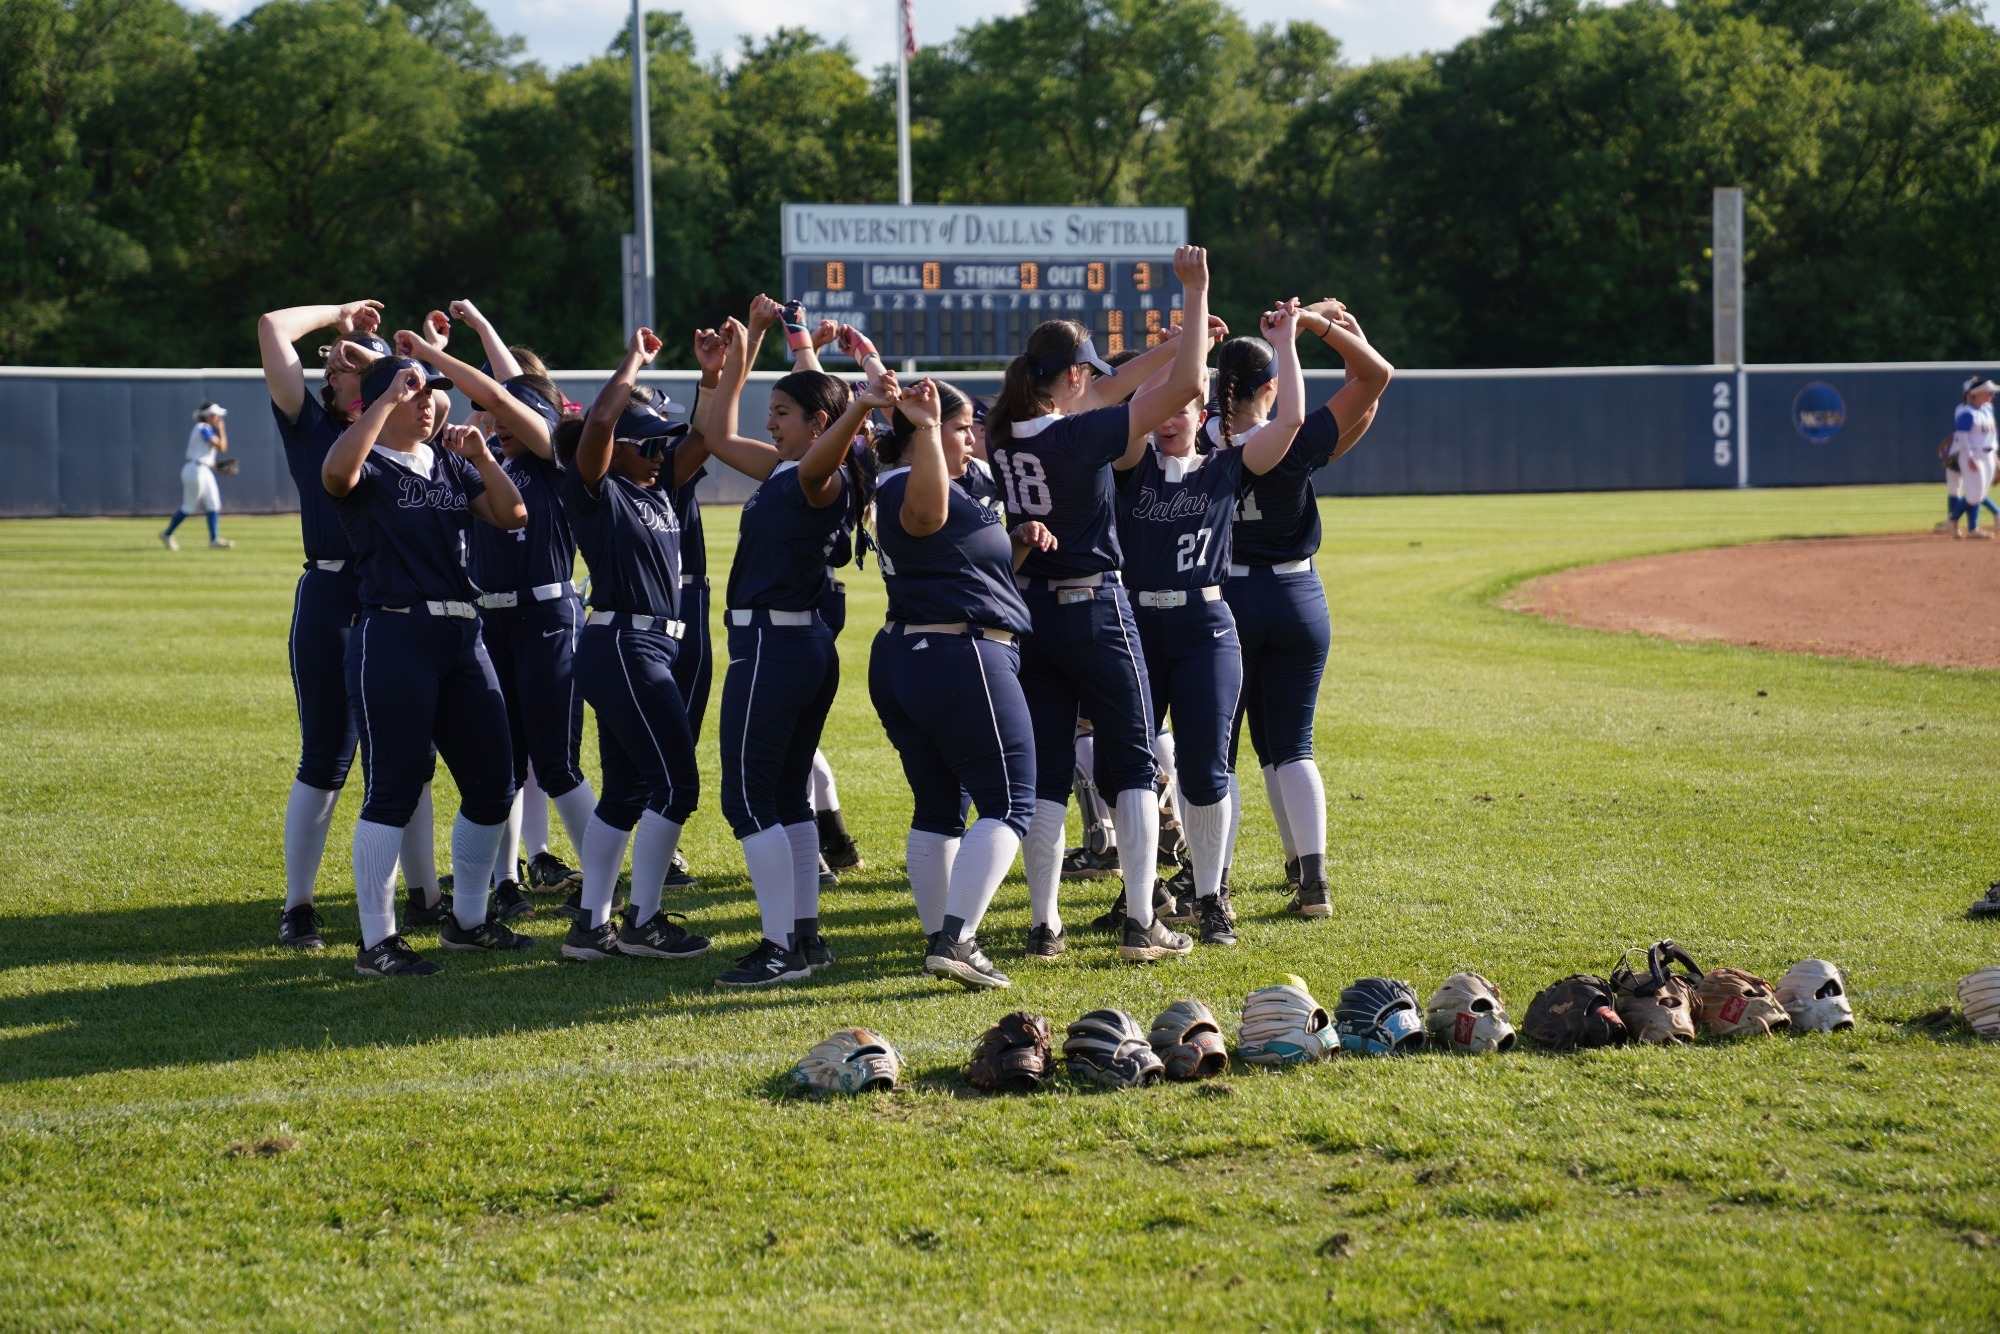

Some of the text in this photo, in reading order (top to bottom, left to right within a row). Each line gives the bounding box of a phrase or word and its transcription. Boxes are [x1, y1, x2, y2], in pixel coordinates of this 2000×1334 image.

[795, 212, 1178, 245] UNIVERSITY of DALLAS SOFTBALL
[871, 265, 921, 286] BALL
[953, 265, 1020, 287] STRIKE
[1047, 265, 1086, 287] OUT
[825, 291, 855, 308] BAT
[873, 293, 884, 310] 1
[893, 293, 905, 310] 2
[914, 293, 927, 310] 3
[940, 293, 953, 310] 4
[981, 293, 994, 310] 6
[1009, 293, 1020, 310] 7
[1066, 293, 1085, 310] 10
[804, 311, 867, 332] ISITOR
[1712, 381, 1732, 467] 205
[993, 448, 1053, 516] 18
[1177, 527, 1212, 573] 27
